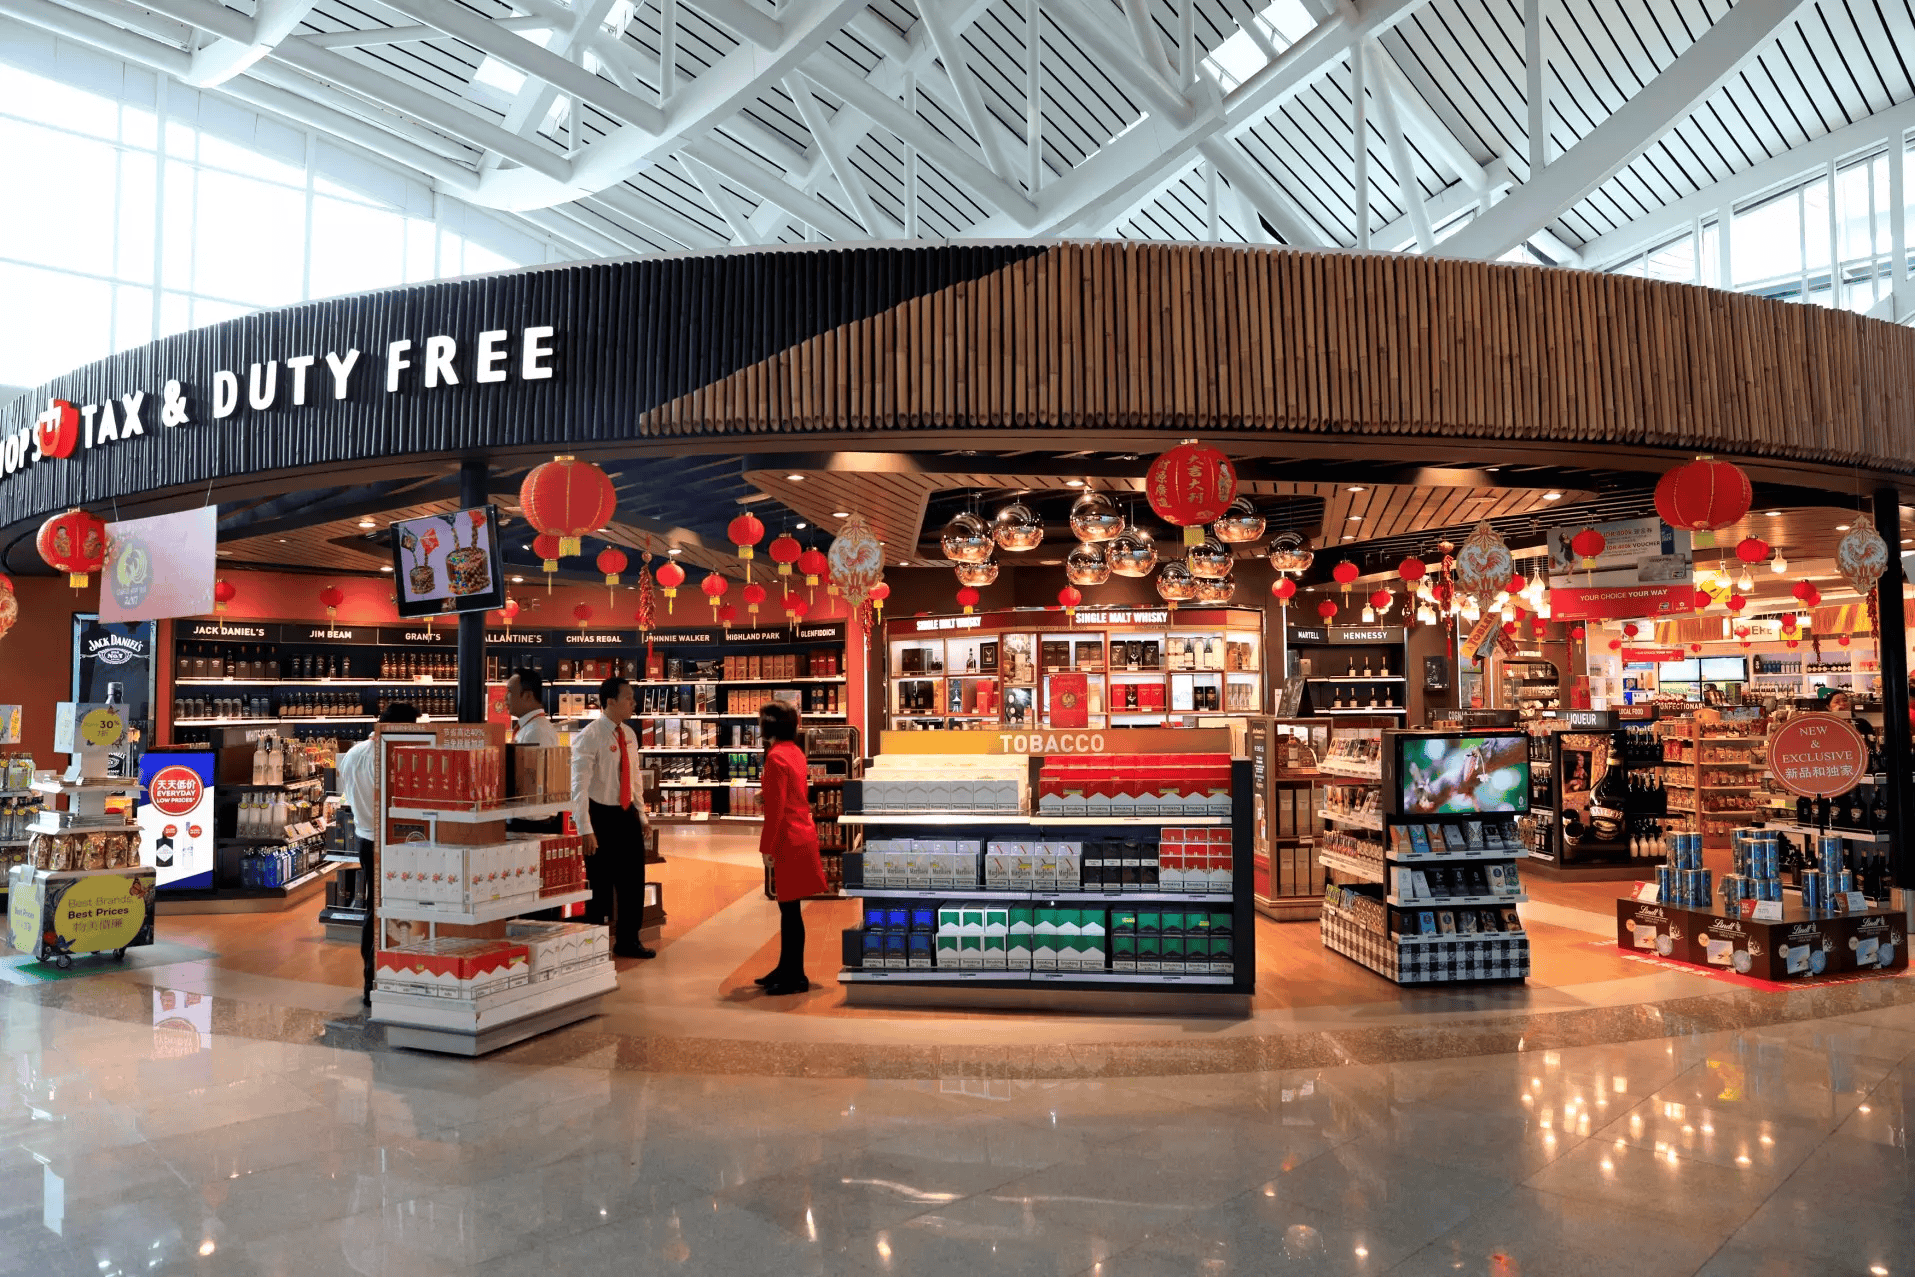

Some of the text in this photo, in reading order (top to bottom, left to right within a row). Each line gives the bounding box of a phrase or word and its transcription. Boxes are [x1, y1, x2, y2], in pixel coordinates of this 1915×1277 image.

[0, 325, 554, 478] OPS TAX & DUTY FREE
[1632, 540, 1660, 548] VOUCHER
[1600, 592, 1627, 600] CHOICE
[1628, 590, 1649, 598] YOUR
[1075, 612, 1168, 624] SINGLE MALT WHISKY
[193, 625, 265, 637] JACK DANIEL'S
[310, 629, 352, 640] JIM BEAM
[405, 632, 441, 641] GRANT'S
[726, 632, 780, 641] HIGHLAND PARK
[800, 628, 836, 638] GLENFIDDICH
[1298, 631, 1320, 640] MARTELL
[1343, 631, 1388, 640] HENNESSY
[88, 634, 144, 653] JACK DANIEL'S
[566, 635, 622, 643] CHIVAS REGAL
[678, 634, 710, 643] WALKER
[100, 720, 120, 729] 30%
[1566, 713, 1597, 726] LIQUEUR
[1799, 726, 1828, 736] NEW
[999, 733, 1105, 753] TOBACCO
[1811, 740, 1820, 749] &
[1782, 750, 1853, 764] EXCLUSIVE
[1785, 765, 1854, 779] 新品和独家
[157, 779, 197, 790] 天天低价
[68, 907, 129, 920] Best Prices
[1640, 905, 1659, 916] Lindt
[1713, 919, 1736, 930] Lindt
[1861, 917, 1880, 927] Lindt
[1792, 924, 1811, 935] Lindt
